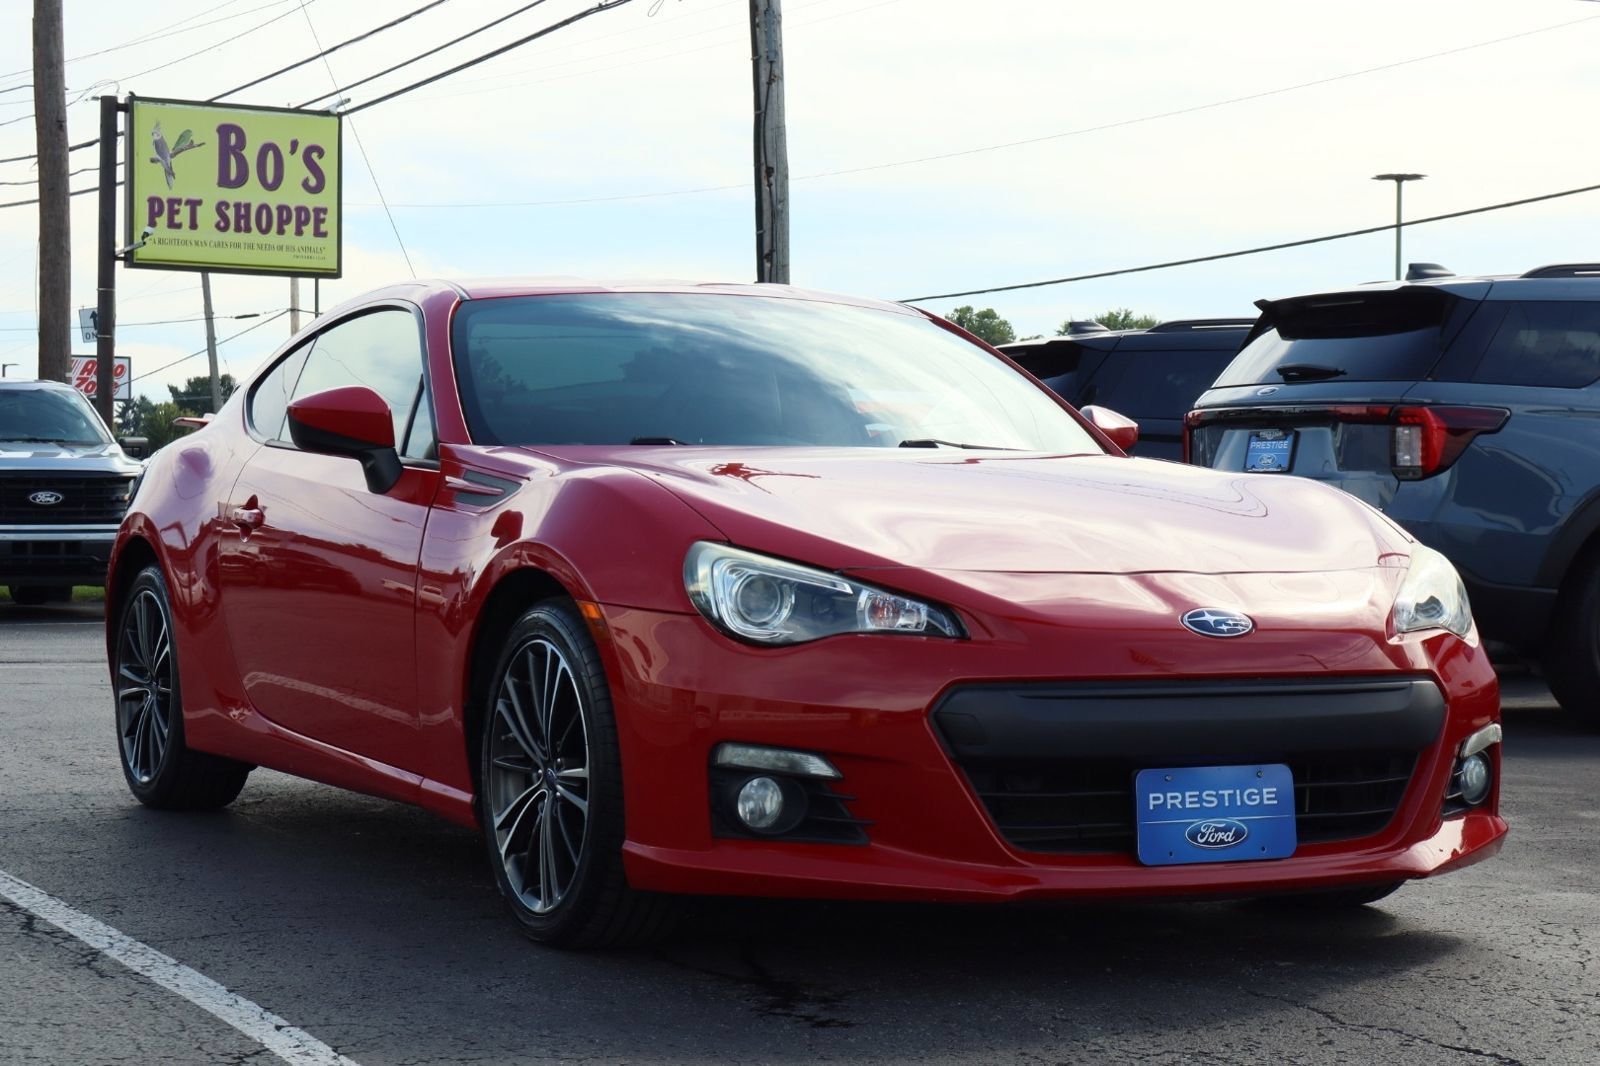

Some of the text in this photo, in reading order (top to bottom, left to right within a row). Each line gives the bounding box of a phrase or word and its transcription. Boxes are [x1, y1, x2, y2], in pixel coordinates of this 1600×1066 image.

[147, 195, 329, 238] PET SHOPPE
[157, 237, 193, 247] RIGHTEOUS
[194, 239, 208, 247] MAN
[208, 240, 229, 249] CARES
[229, 241, 242, 249] FOR
[243, 242, 255, 250] THE
[256, 242, 276, 252] NEEDS
[285, 244, 297, 253] HIS
[85, 332, 98, 340] ON
[1250, 440, 1289, 449] PRESTIGE
[1148, 788, 1278, 810] PRESTIGE
[1197, 822, 1236, 844] Ford
